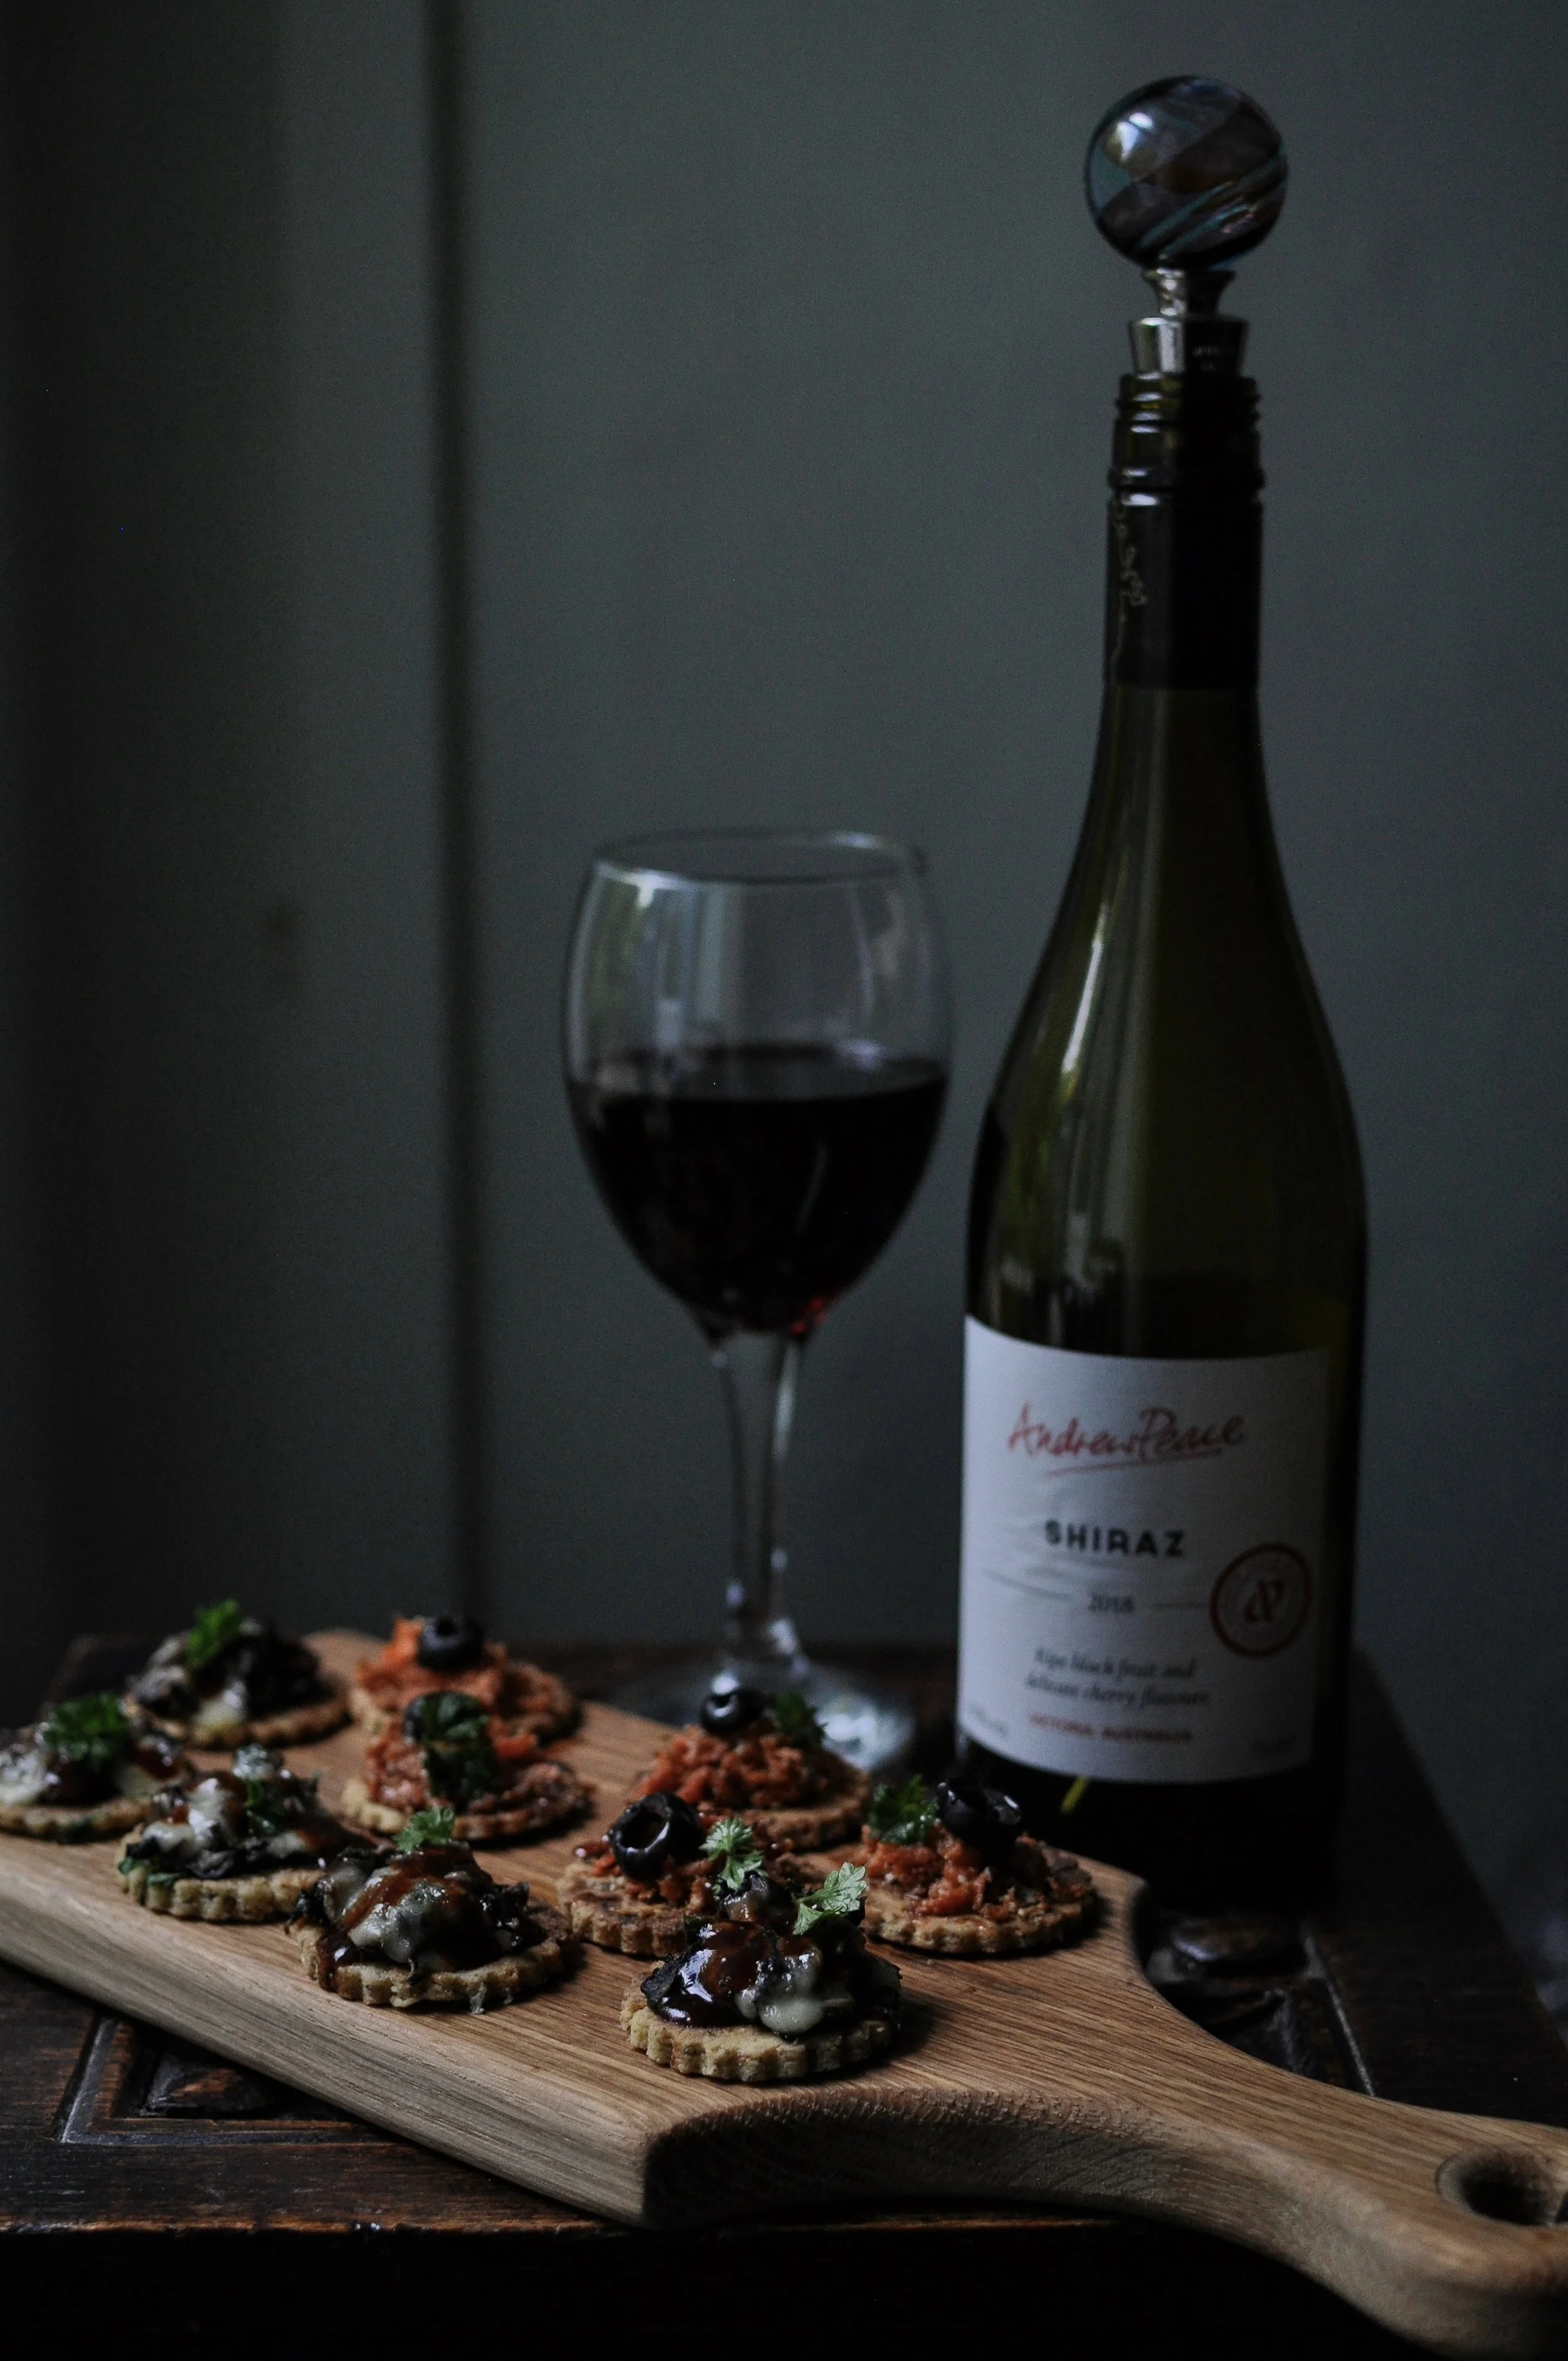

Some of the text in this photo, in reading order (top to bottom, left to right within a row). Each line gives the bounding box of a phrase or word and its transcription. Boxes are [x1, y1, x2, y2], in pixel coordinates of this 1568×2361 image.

[1007, 1401, 1245, 1463] Andrew Peace
[1044, 1519, 1186, 1557] SHIRAZ
[1161, 1657, 1197, 1678] and
